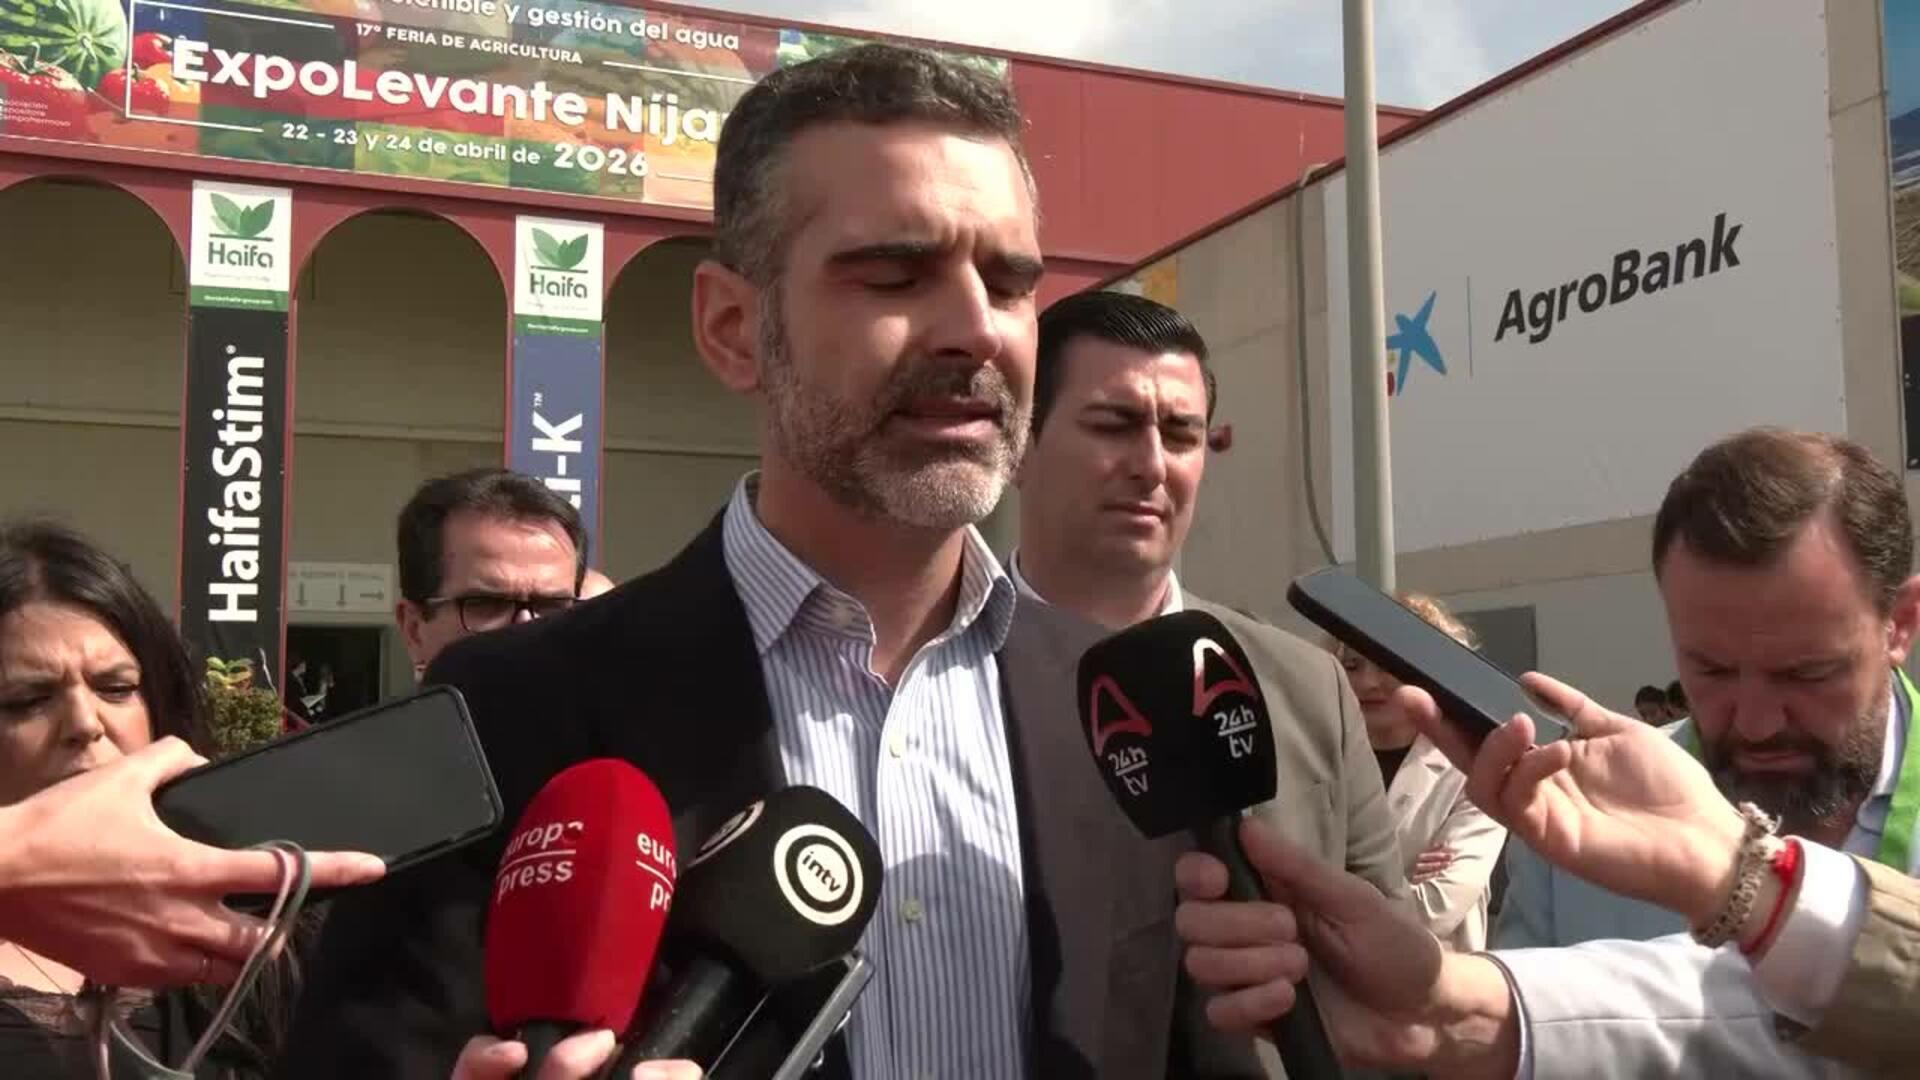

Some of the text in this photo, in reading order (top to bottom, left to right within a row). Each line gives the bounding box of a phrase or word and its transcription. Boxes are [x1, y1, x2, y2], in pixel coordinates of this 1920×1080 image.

[386, 27, 437, 45] FERIA
[442, 34, 465, 48] DE
[470, 38, 582, 64] AGRICULTURA
[503, 4, 519, 24] y
[528, 7, 622, 35] gestión
[630, 16, 668, 40] del
[675, 28, 739, 50] agua
[172, 37, 588, 127] ExpoLevante
[282, 123, 309, 140] 22
[333, 128, 358, 145] 23
[365, 133, 379, 151] y
[386, 135, 412, 151] 24
[418, 137, 448, 154] de
[453, 141, 506, 161] abril
[512, 146, 541, 165] de
[553, 143, 648, 176] 2026
[208, 241, 274, 268] Haifa
[529, 272, 588, 299] Haifa
[1494, 212, 1743, 344] AgroBank
[1214, 705, 1255, 730] 24h
[1107, 746, 1147, 771] 24h
[1228, 734, 1254, 759] tv
[1122, 772, 1149, 796] tv
[497, 861, 574, 905] press
[802, 851, 841, 893] intv
